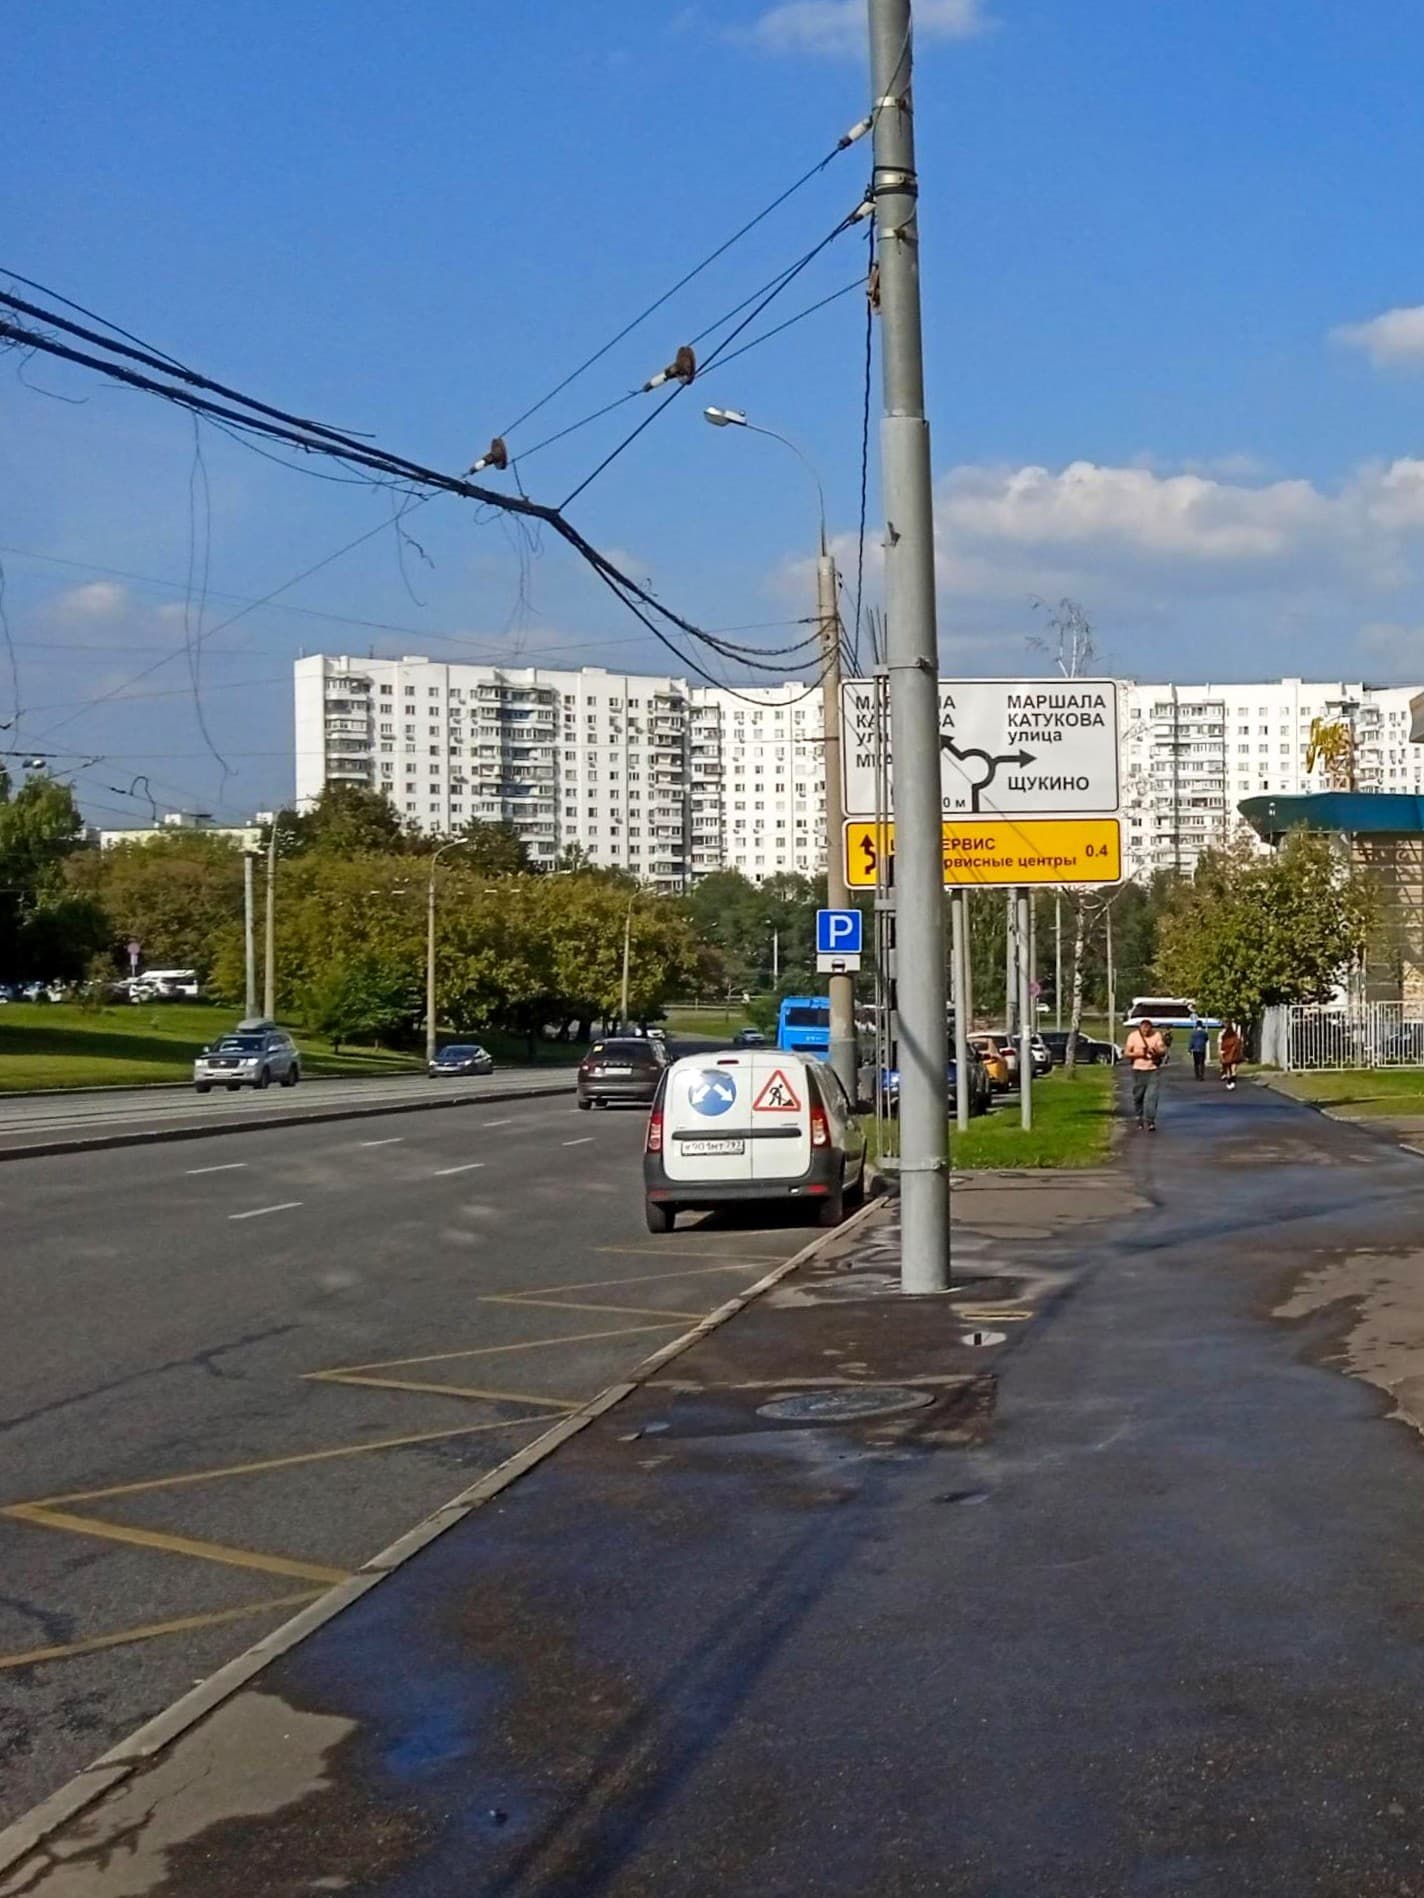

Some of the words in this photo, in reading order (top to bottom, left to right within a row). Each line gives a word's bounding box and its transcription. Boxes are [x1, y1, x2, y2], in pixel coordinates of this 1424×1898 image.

[1007, 694, 1106, 709] МАРШАЛА
[1008, 713, 1105, 727] КАТУКОВА
[1007, 731, 1062, 746] улица
[1008, 776, 1090, 793] ЩУКИНО
[955, 799, 966, 808] м
[1085, 844, 1109, 857] 0.4
[1018, 855, 1077, 868] центры
[829, 915, 853, 948] P
